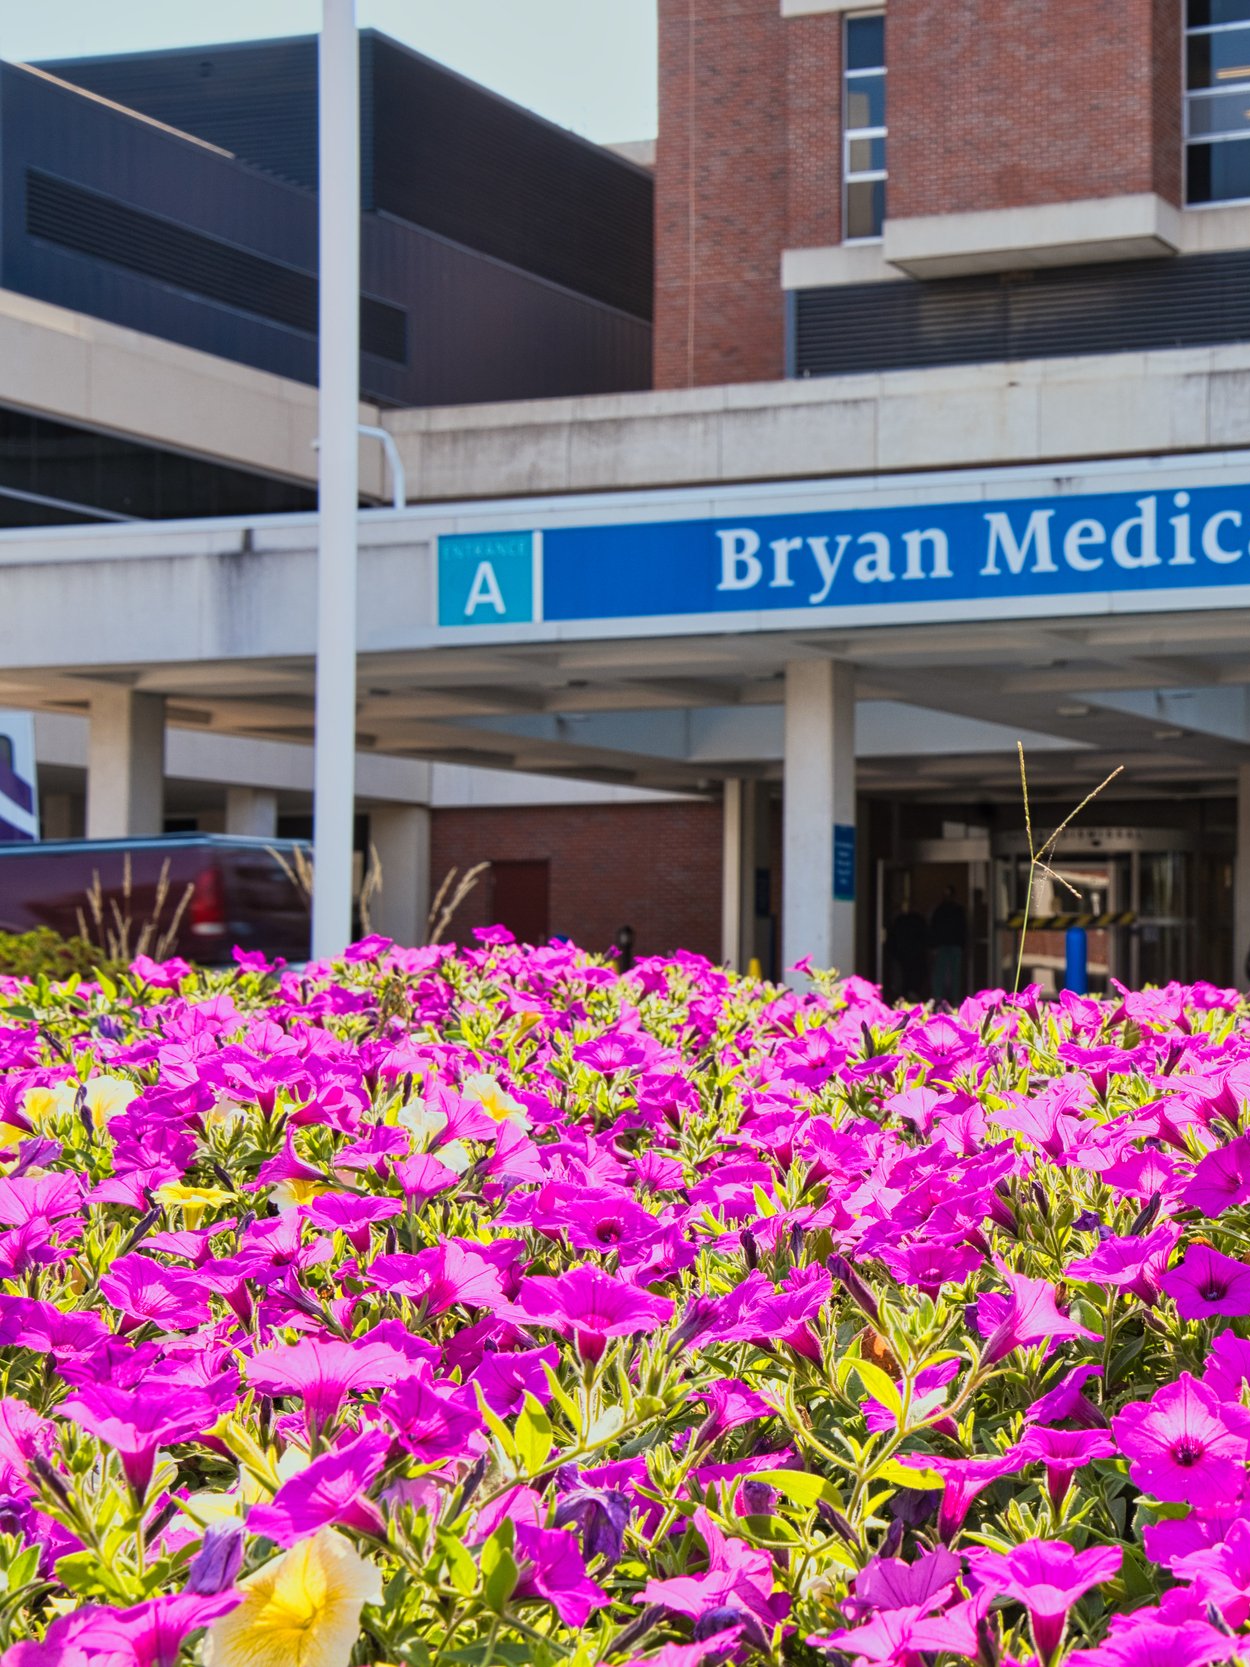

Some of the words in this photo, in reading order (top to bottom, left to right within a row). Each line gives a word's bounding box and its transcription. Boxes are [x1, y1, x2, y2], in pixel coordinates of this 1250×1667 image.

[442, 541, 525, 559] ENTRANCE
[717, 529, 952, 604] Bryan
[464, 561, 506, 615] A
